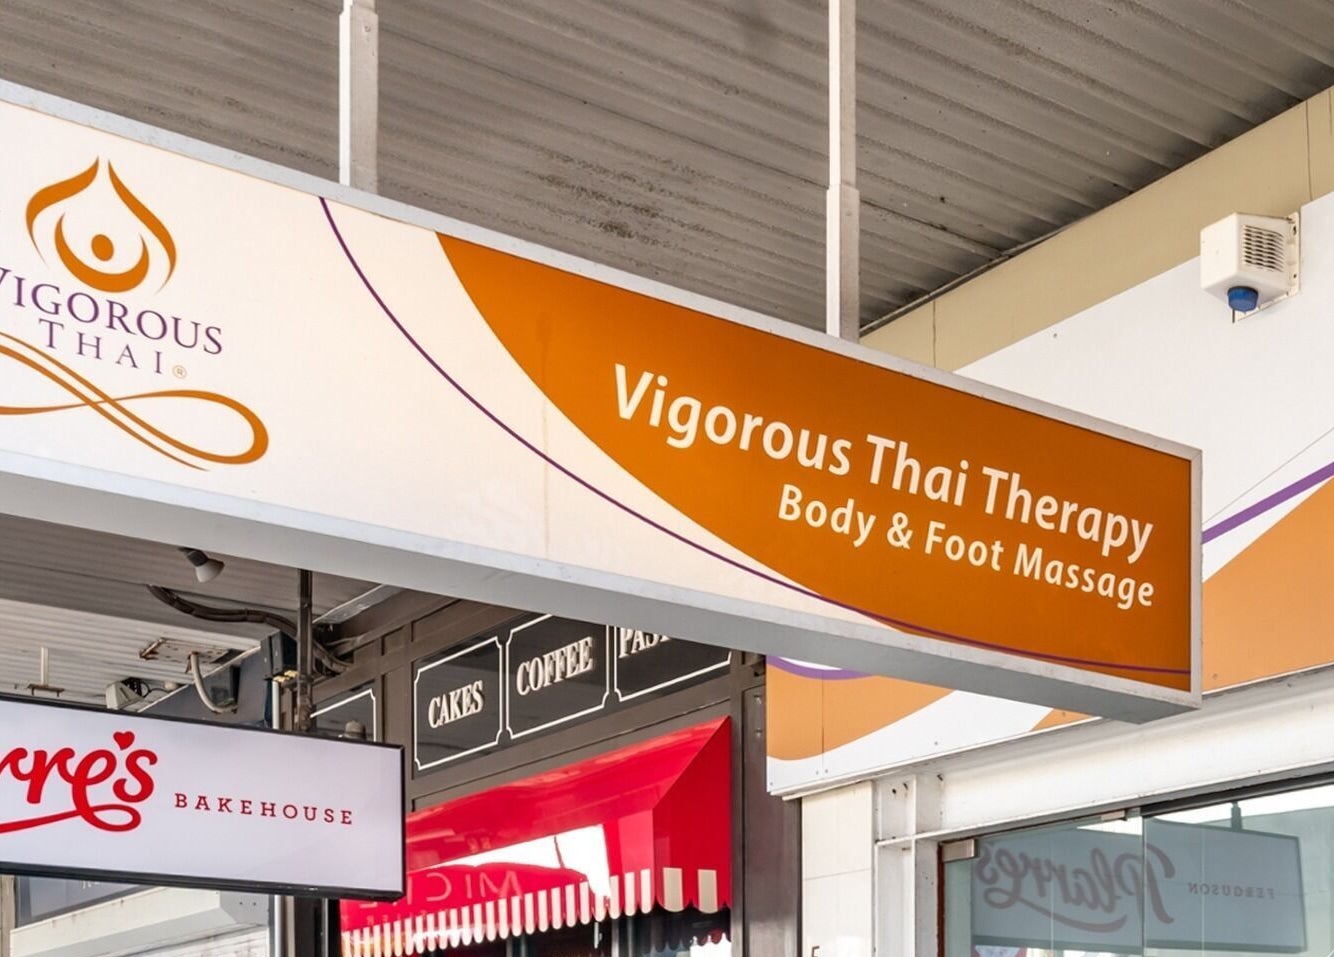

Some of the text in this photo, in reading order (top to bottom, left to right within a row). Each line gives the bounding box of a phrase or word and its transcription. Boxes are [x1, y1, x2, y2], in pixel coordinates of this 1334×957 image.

[613, 363, 1154, 564] Vigorous Thai Therapy
[777, 483, 1155, 611] Body & Foot Massage
[516, 636, 595, 696] COFFEE
[428, 680, 484, 729] CAKES
[175, 793, 353, 825] BAKEHOUSE
